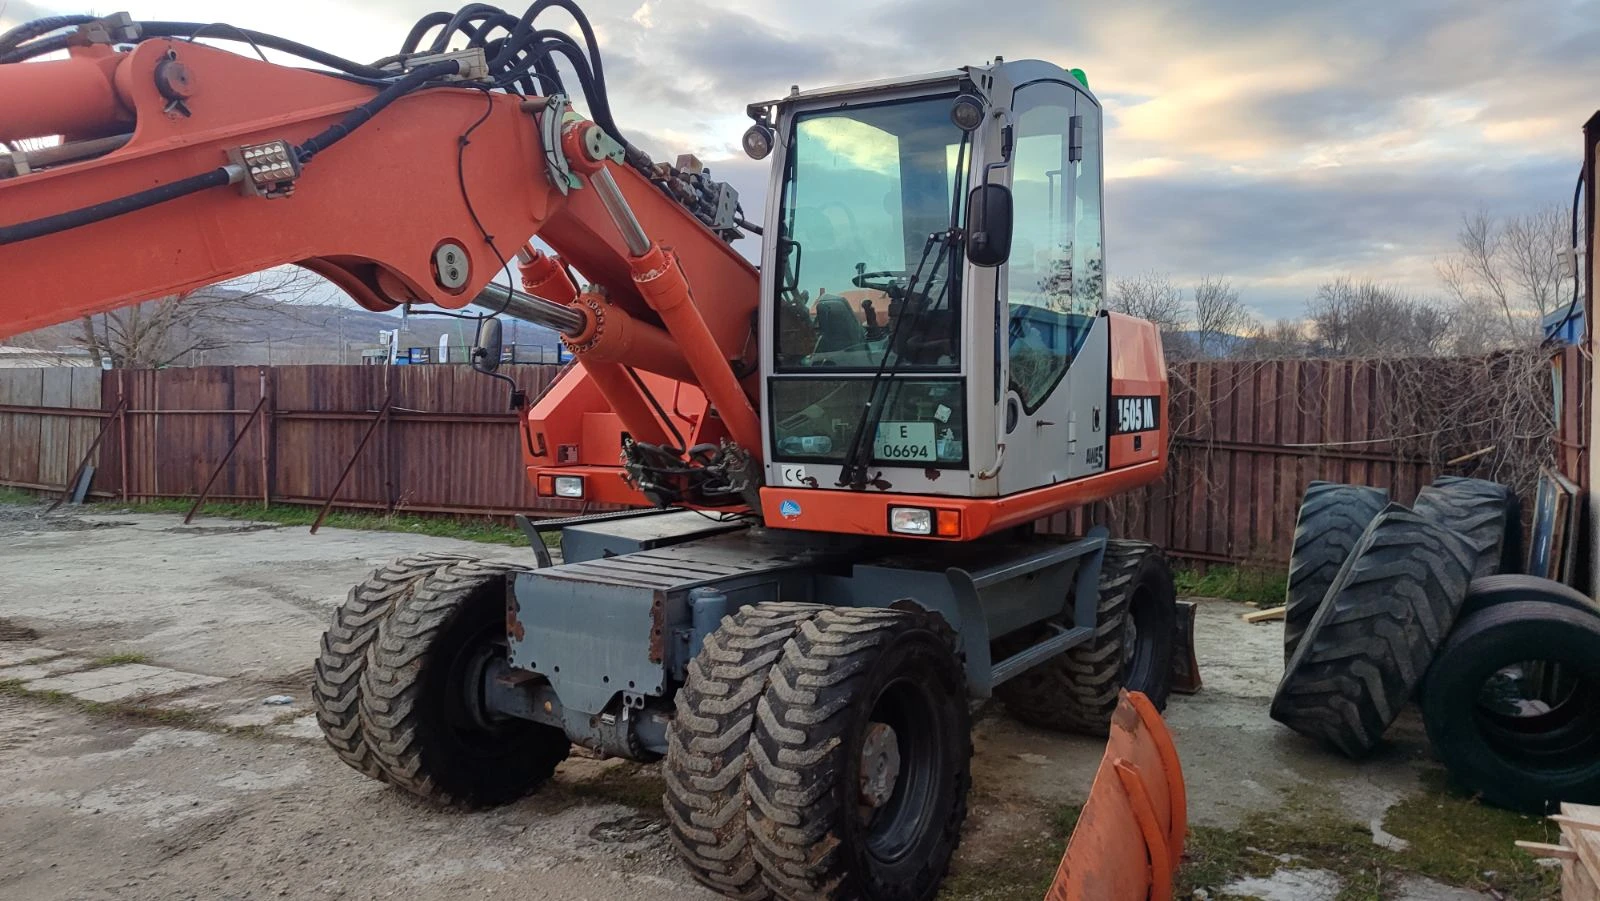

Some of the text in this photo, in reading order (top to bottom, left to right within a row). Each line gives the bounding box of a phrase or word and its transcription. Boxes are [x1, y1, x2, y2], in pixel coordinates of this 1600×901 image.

[1118, 398, 1154, 432] 1505 M
[900, 426, 908, 438] E
[883, 445, 929, 458] 06694
[785, 469, 803, 483] CE
